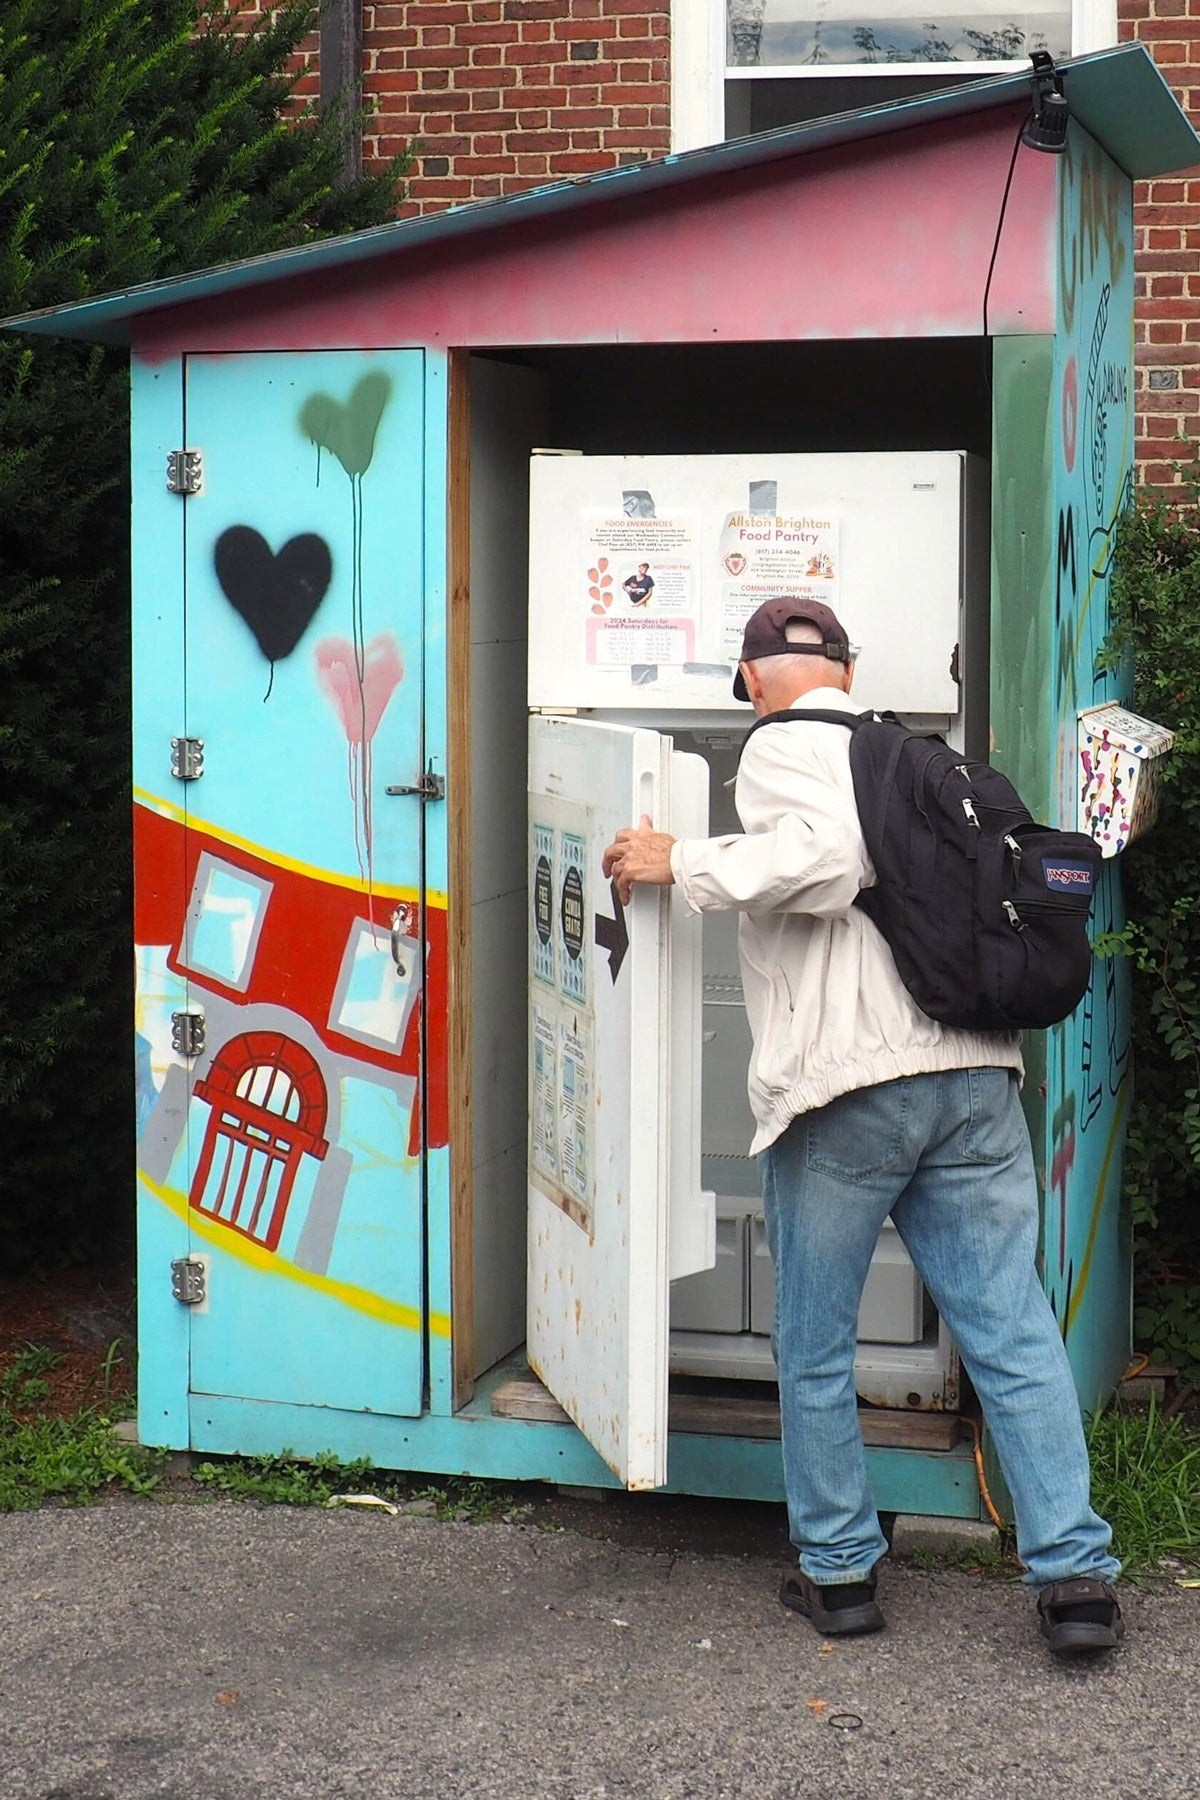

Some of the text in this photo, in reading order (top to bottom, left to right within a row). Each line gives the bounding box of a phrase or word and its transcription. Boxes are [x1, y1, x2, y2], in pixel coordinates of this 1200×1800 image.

[627, 520, 672, 528] EMERGENCIES
[728, 516, 831, 532] Allston Brighton
[740, 529, 819, 545] Food Pantry
[740, 584, 813, 593] COMMUNITY SUPPER
[1047, 868, 1090, 885] JANSPORT
[539, 885, 549, 903] FREE
